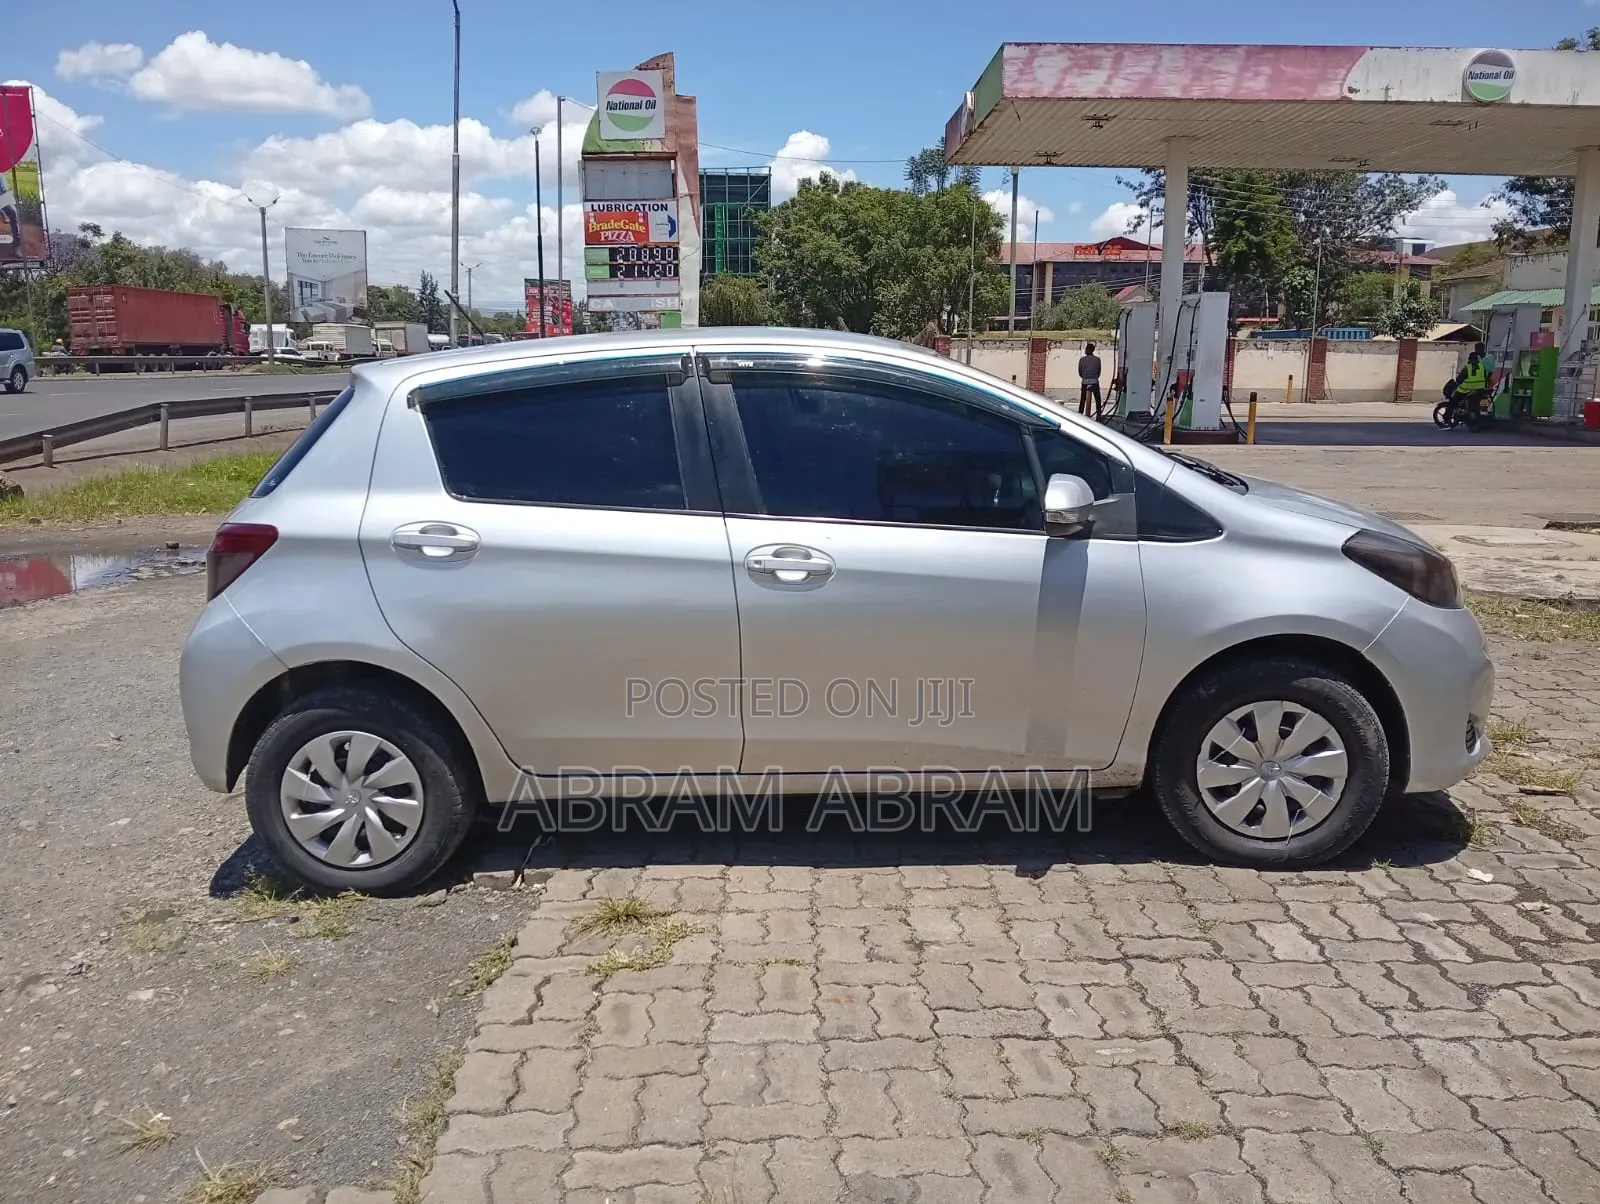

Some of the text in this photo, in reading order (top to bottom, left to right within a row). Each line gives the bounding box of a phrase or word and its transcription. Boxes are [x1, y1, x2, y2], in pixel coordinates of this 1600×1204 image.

[1468, 70, 1514, 80] National Oil
[606, 96, 657, 111] National Oil
[591, 203, 668, 212] LUBRICATION
[588, 219, 646, 233] BradeGate
[600, 231, 635, 242] PIZZA
